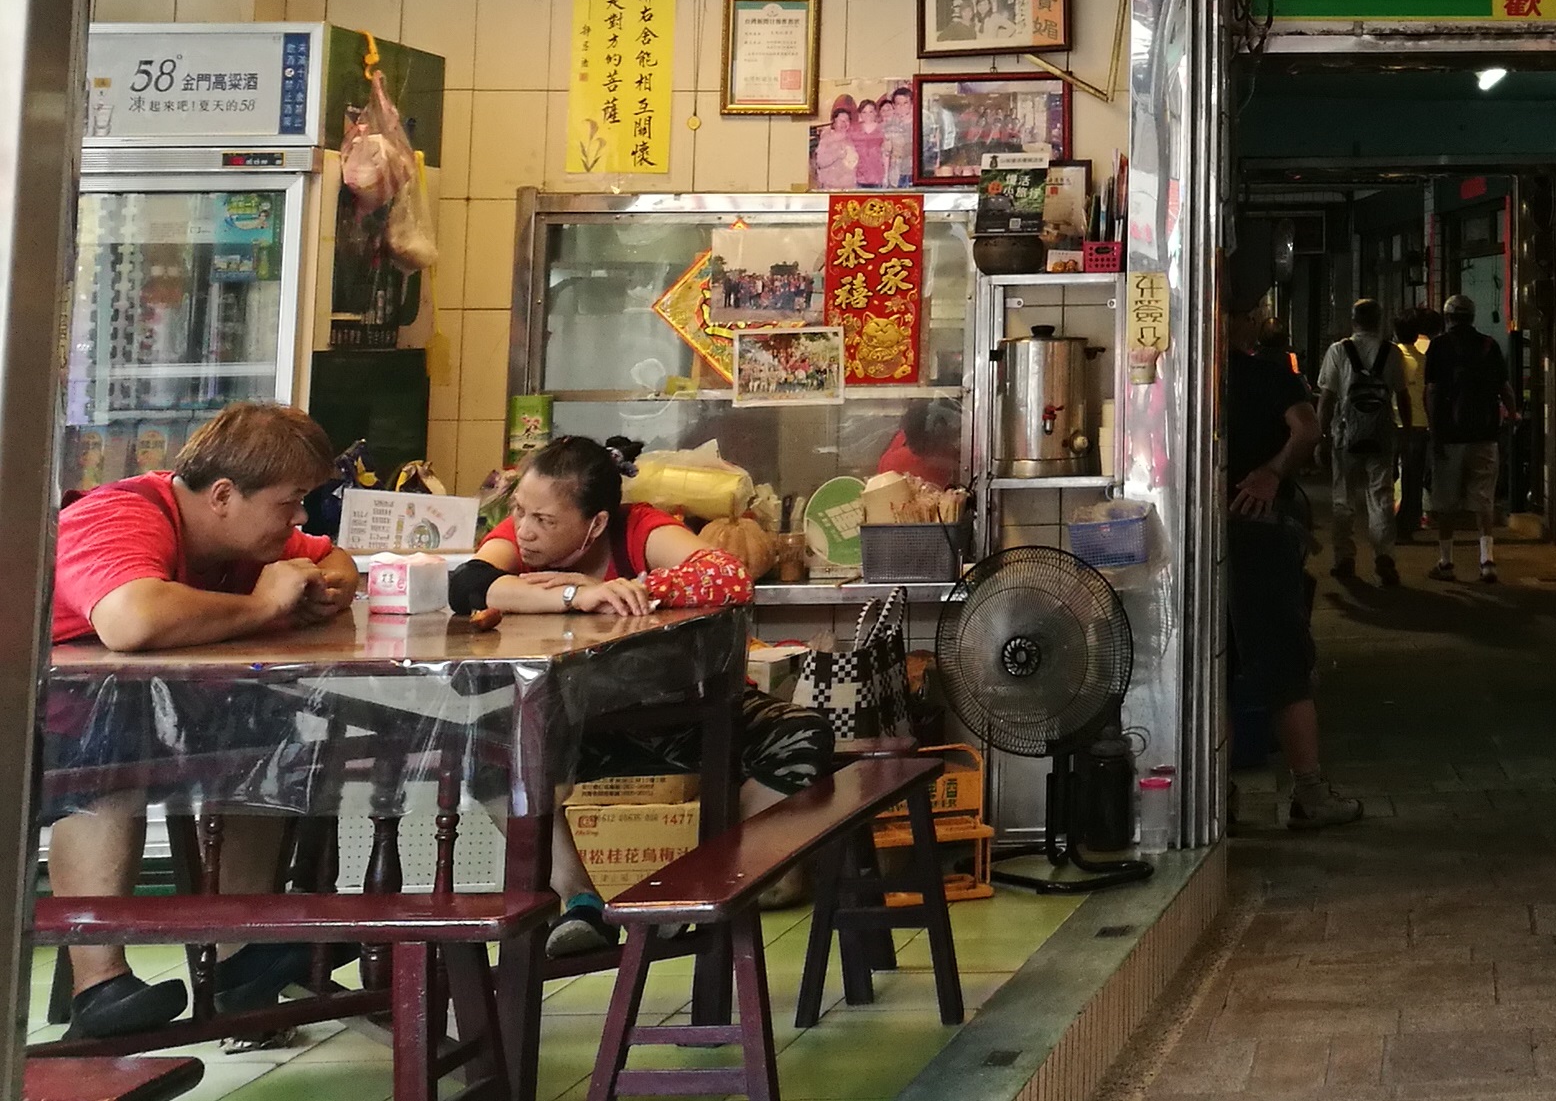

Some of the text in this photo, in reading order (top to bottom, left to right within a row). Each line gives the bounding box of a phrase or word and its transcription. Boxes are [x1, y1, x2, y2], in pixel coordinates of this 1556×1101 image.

[833, 227, 876, 310] 恭禧
[875, 214, 917, 296] 大家
[662, 813, 694, 826] 1477
